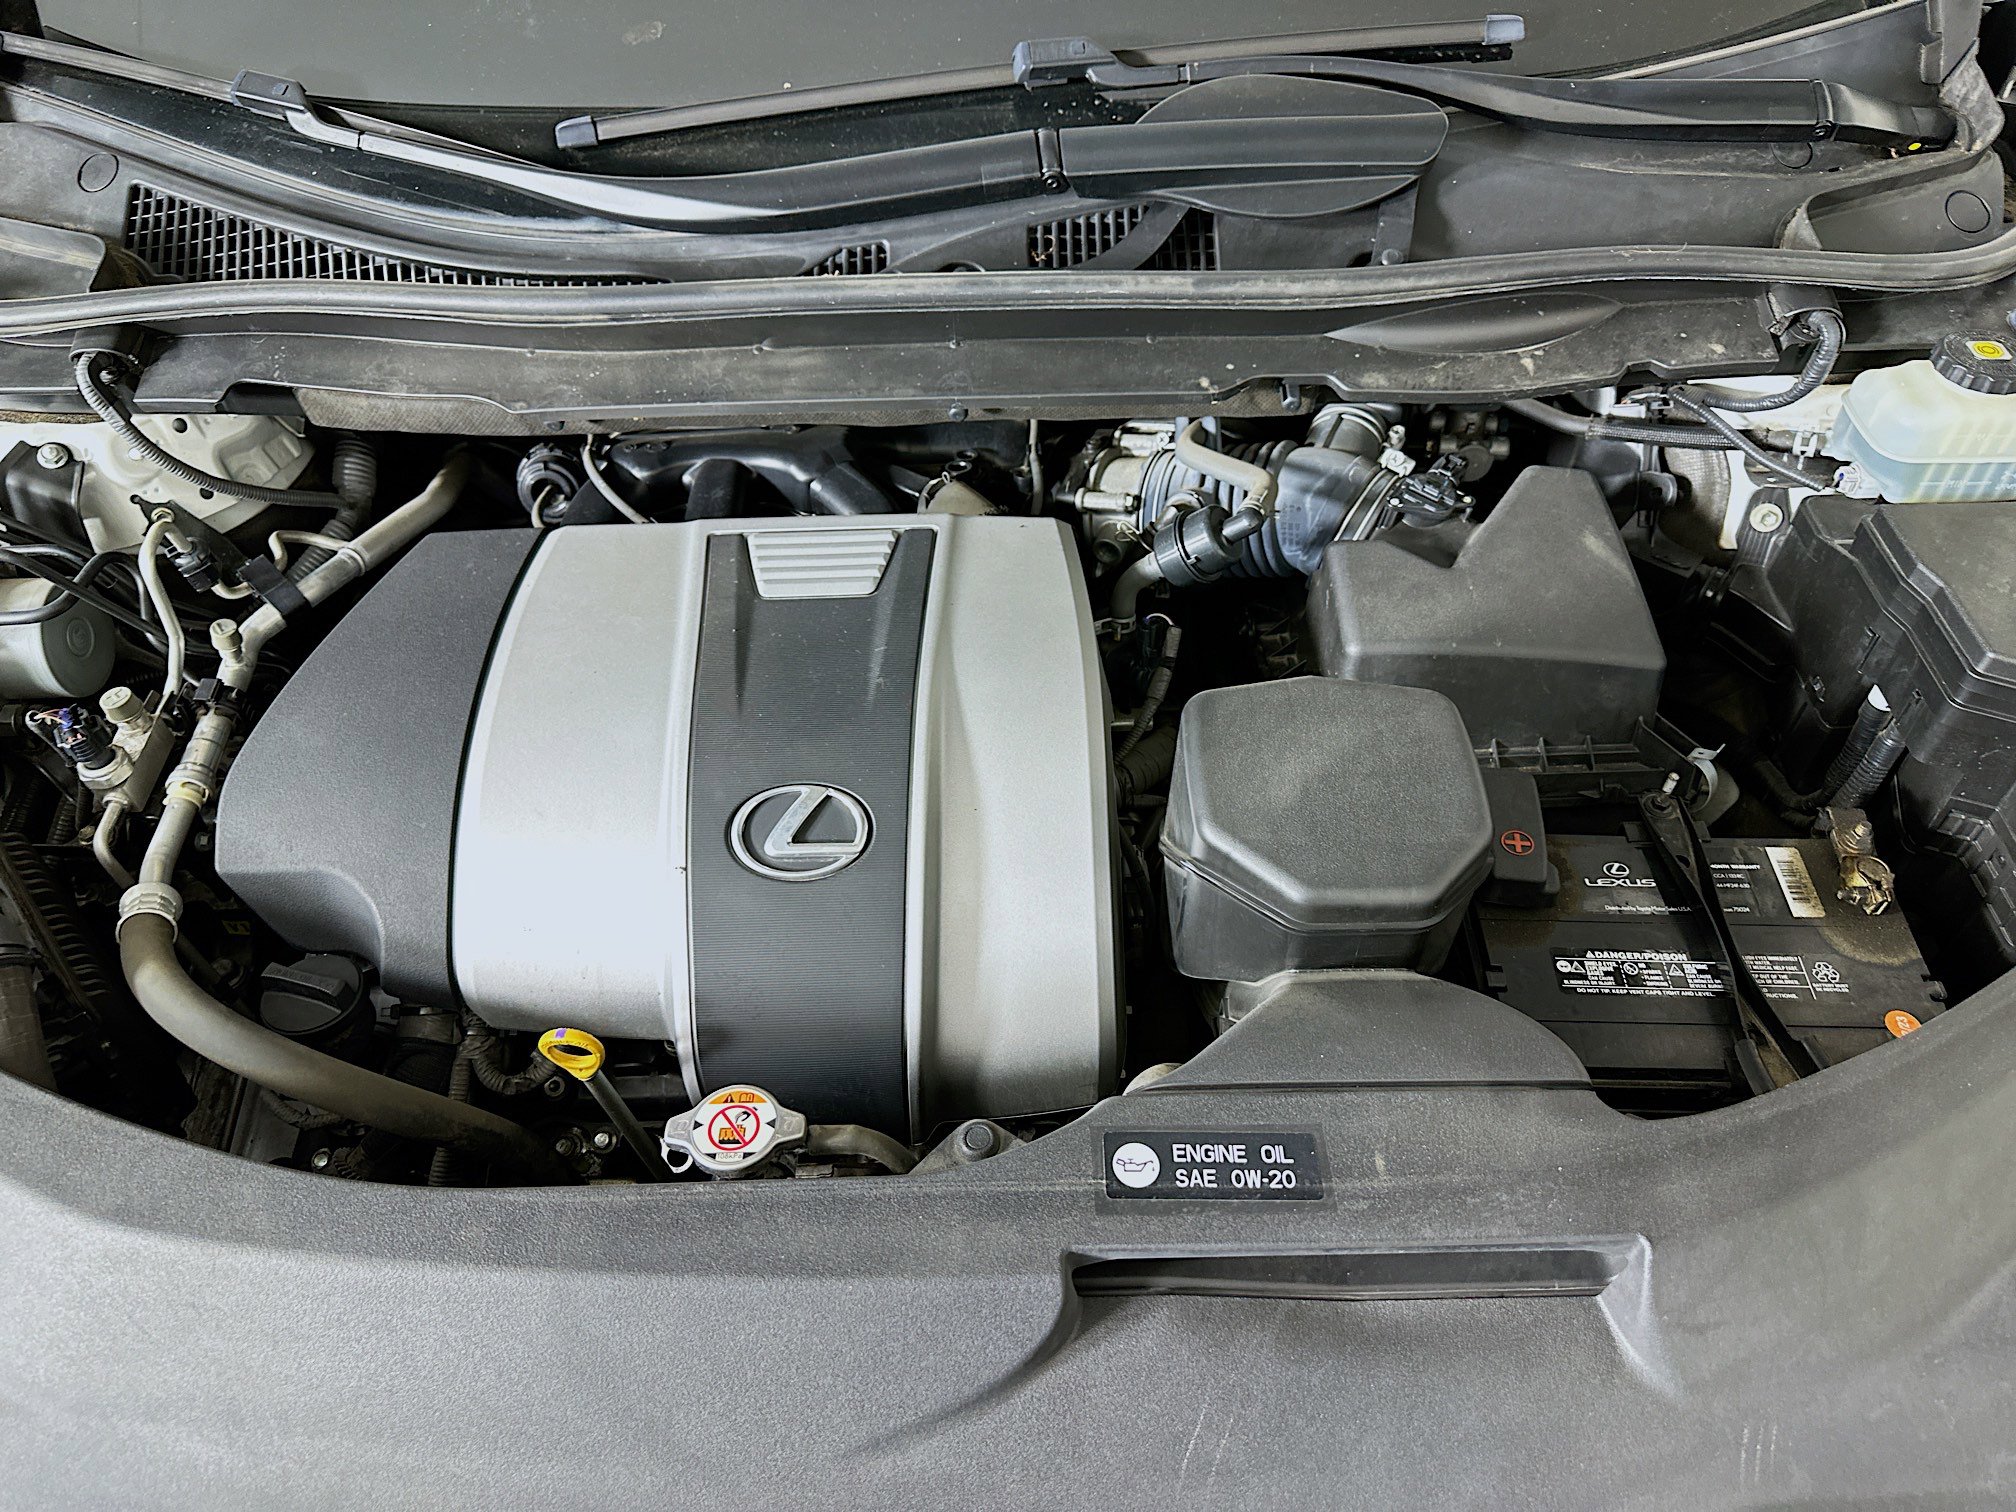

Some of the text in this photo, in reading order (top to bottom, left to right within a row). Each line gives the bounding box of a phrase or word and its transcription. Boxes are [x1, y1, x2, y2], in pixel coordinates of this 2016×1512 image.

[1584, 877, 1657, 888] LEXUS
[1594, 950, 1688, 961] DANGER/POISON
[1171, 1143, 1295, 1165] ENGINE OIL
[1175, 1168, 1297, 1189] SAE 0W-20
